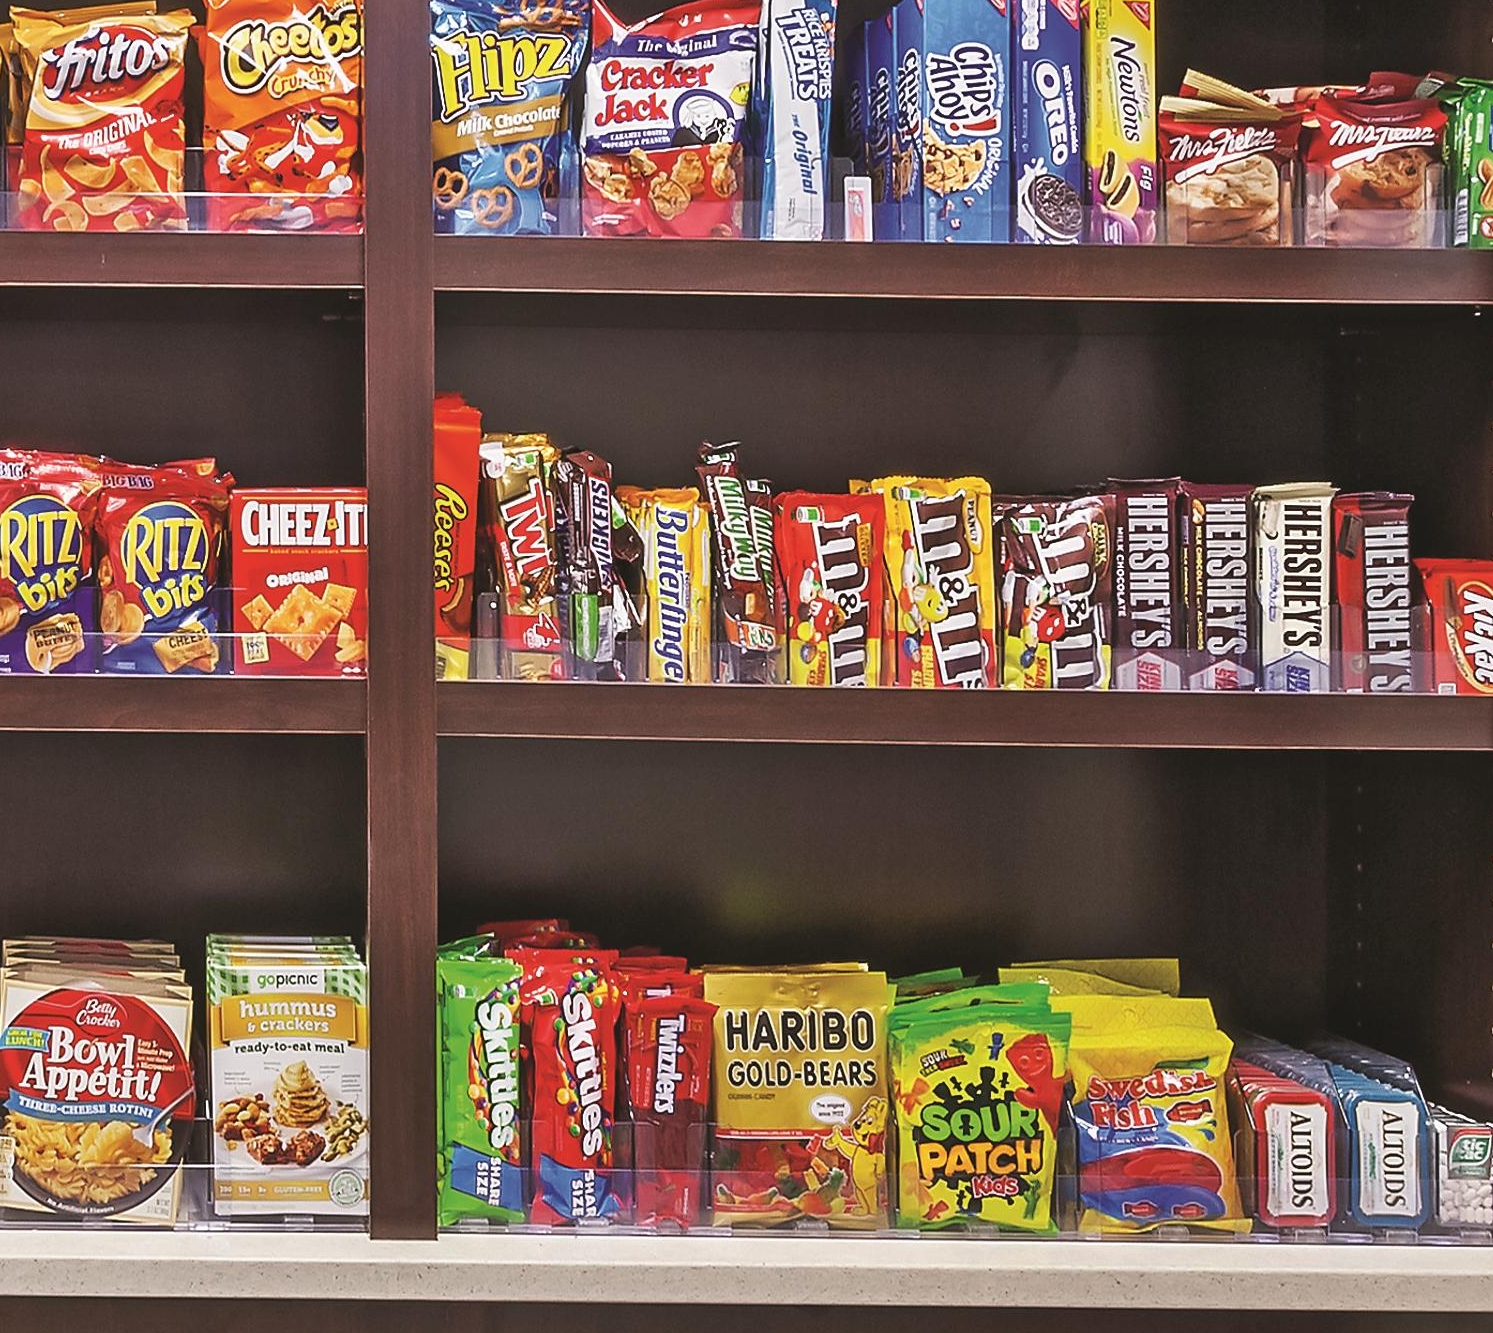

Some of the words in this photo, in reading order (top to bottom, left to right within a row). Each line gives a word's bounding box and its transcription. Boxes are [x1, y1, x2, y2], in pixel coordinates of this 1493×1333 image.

[221, 10, 362, 94] Cheetos
[433, 33, 571, 120] Flipz
[600, 60, 714, 92] Cracker
[954, 45, 992, 117] Chips
[1110, 36, 1140, 144] Newtons
[457, 116, 492, 138] Milk
[495, 106, 561, 130] Chocolate
[594, 94, 668, 128] Jack
[1033, 59, 1068, 166] OREO
[1139, 165, 1153, 191] Fig
[0, 510, 81, 580] RITZ
[127, 518, 206, 583] RITZ
[18, 565, 78, 611] bits
[1127, 496, 1171, 649] HERSHEY'S
[1206, 503, 1247, 656] HERSHEY'S
[1283, 505, 1323, 652] HERSHEY'S
[144, 575, 204, 618] bits
[257, 972, 318, 990] gopicnic
[239, 998, 337, 1020] hummus
[725, 1009, 874, 1054] HARIBO
[48, 1026, 134, 1069] Bowl
[233, 1041, 311, 1056] ready-to-eat
[314, 1042, 345, 1055] meal
[655, 1015, 685, 1116] Twizzlers
[19, 1052, 162, 1102] Appétit!
[728, 1061, 877, 1088] GOLD-BEARS
[1088, 1069, 1215, 1101] Swedish
[920, 1100, 1037, 1143] SOUR
[1088, 1099, 1157, 1130] Fish
[918, 1139, 1043, 1180] PATCH
[1290, 1111, 1314, 1208] ALTOIDS
[1381, 1109, 1406, 1208] ALTOIDS
[971, 1175, 1019, 1198] Kids
